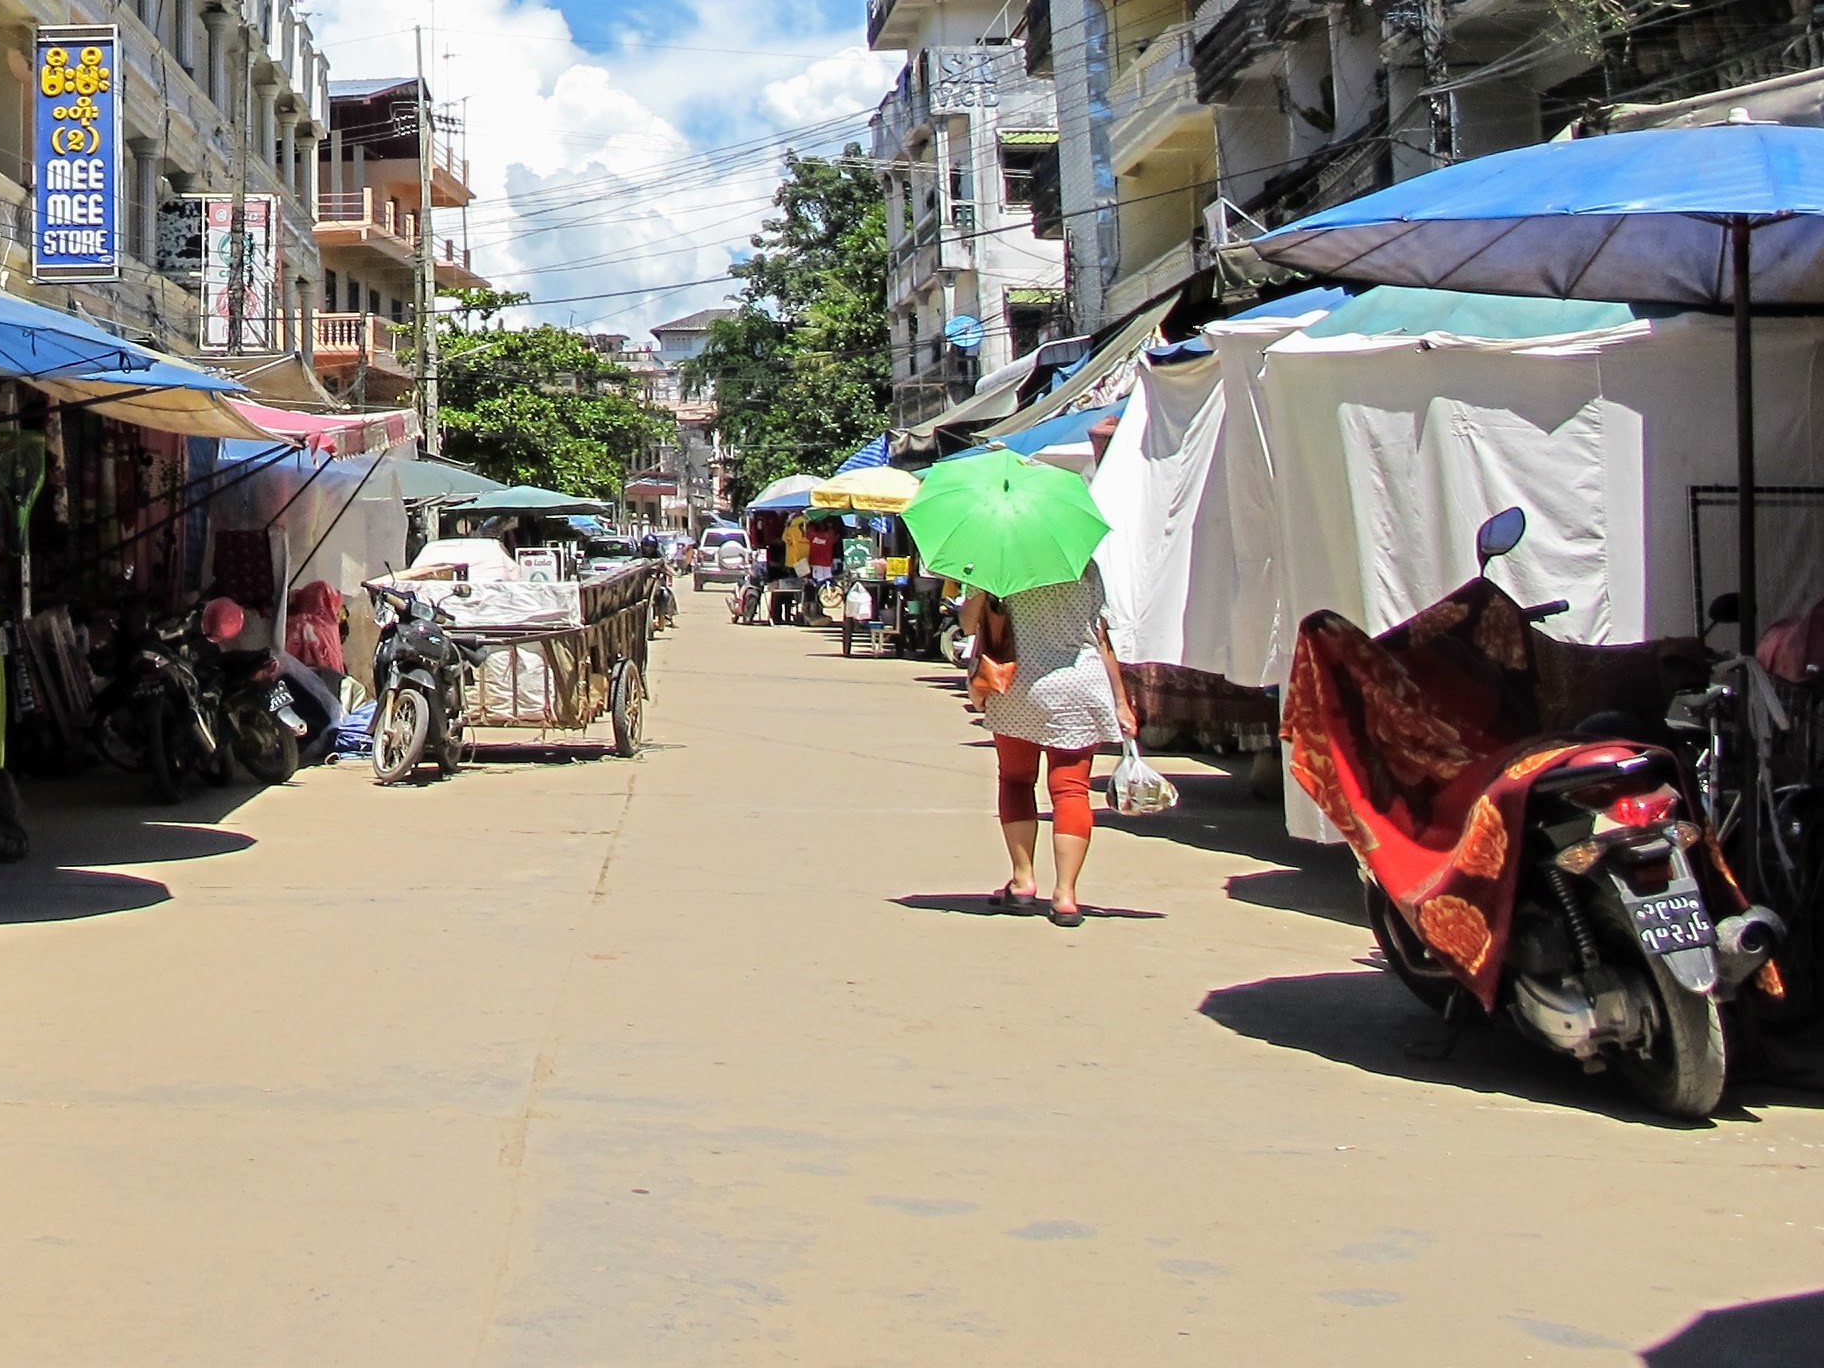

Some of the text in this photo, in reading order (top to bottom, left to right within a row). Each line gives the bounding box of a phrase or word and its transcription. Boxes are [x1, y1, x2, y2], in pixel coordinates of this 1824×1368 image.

[51, 126, 100, 155] (2)
[46, 159, 105, 191] MEE
[46, 194, 105, 226] MEE
[43, 230, 109, 256] STORE
